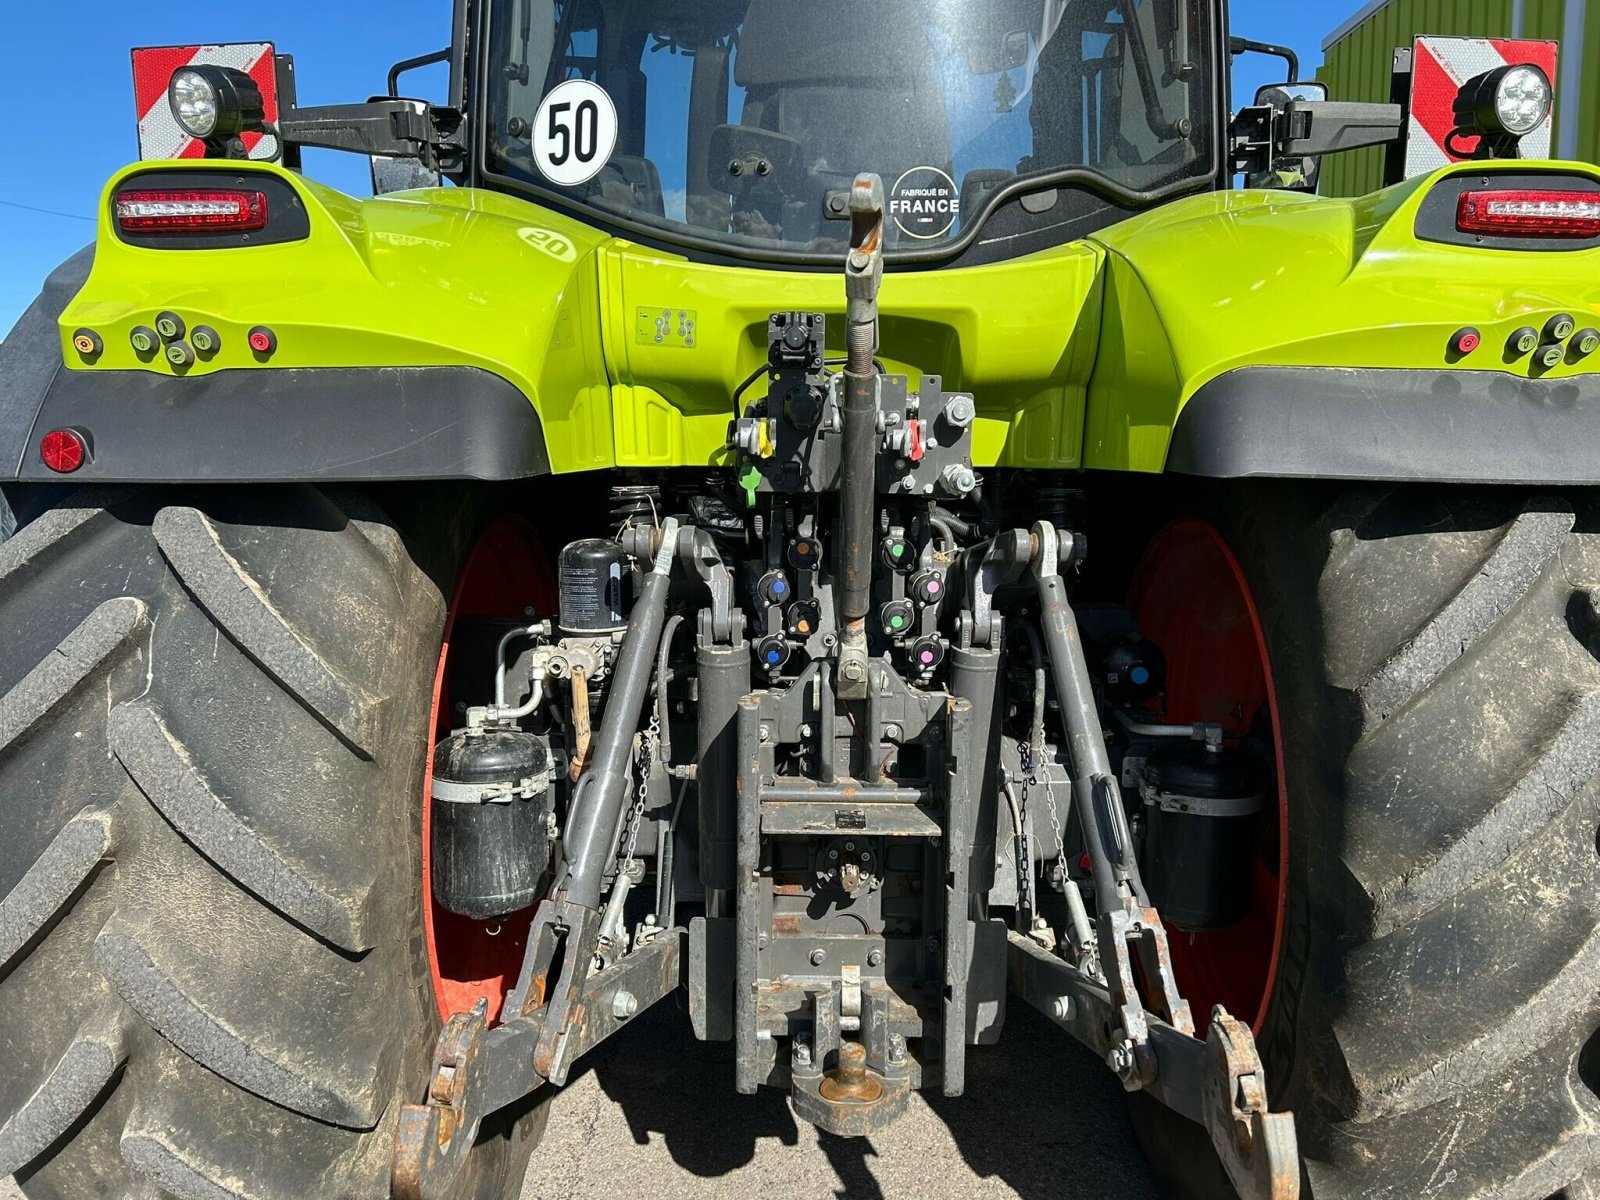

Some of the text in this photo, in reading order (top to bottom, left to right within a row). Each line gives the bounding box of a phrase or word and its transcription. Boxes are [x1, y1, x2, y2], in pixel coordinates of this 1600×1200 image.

[548, 99, 598, 166] 50
[901, 188, 949, 197] FABRIQUÉ EN
[890, 199, 960, 213] FRANCE
